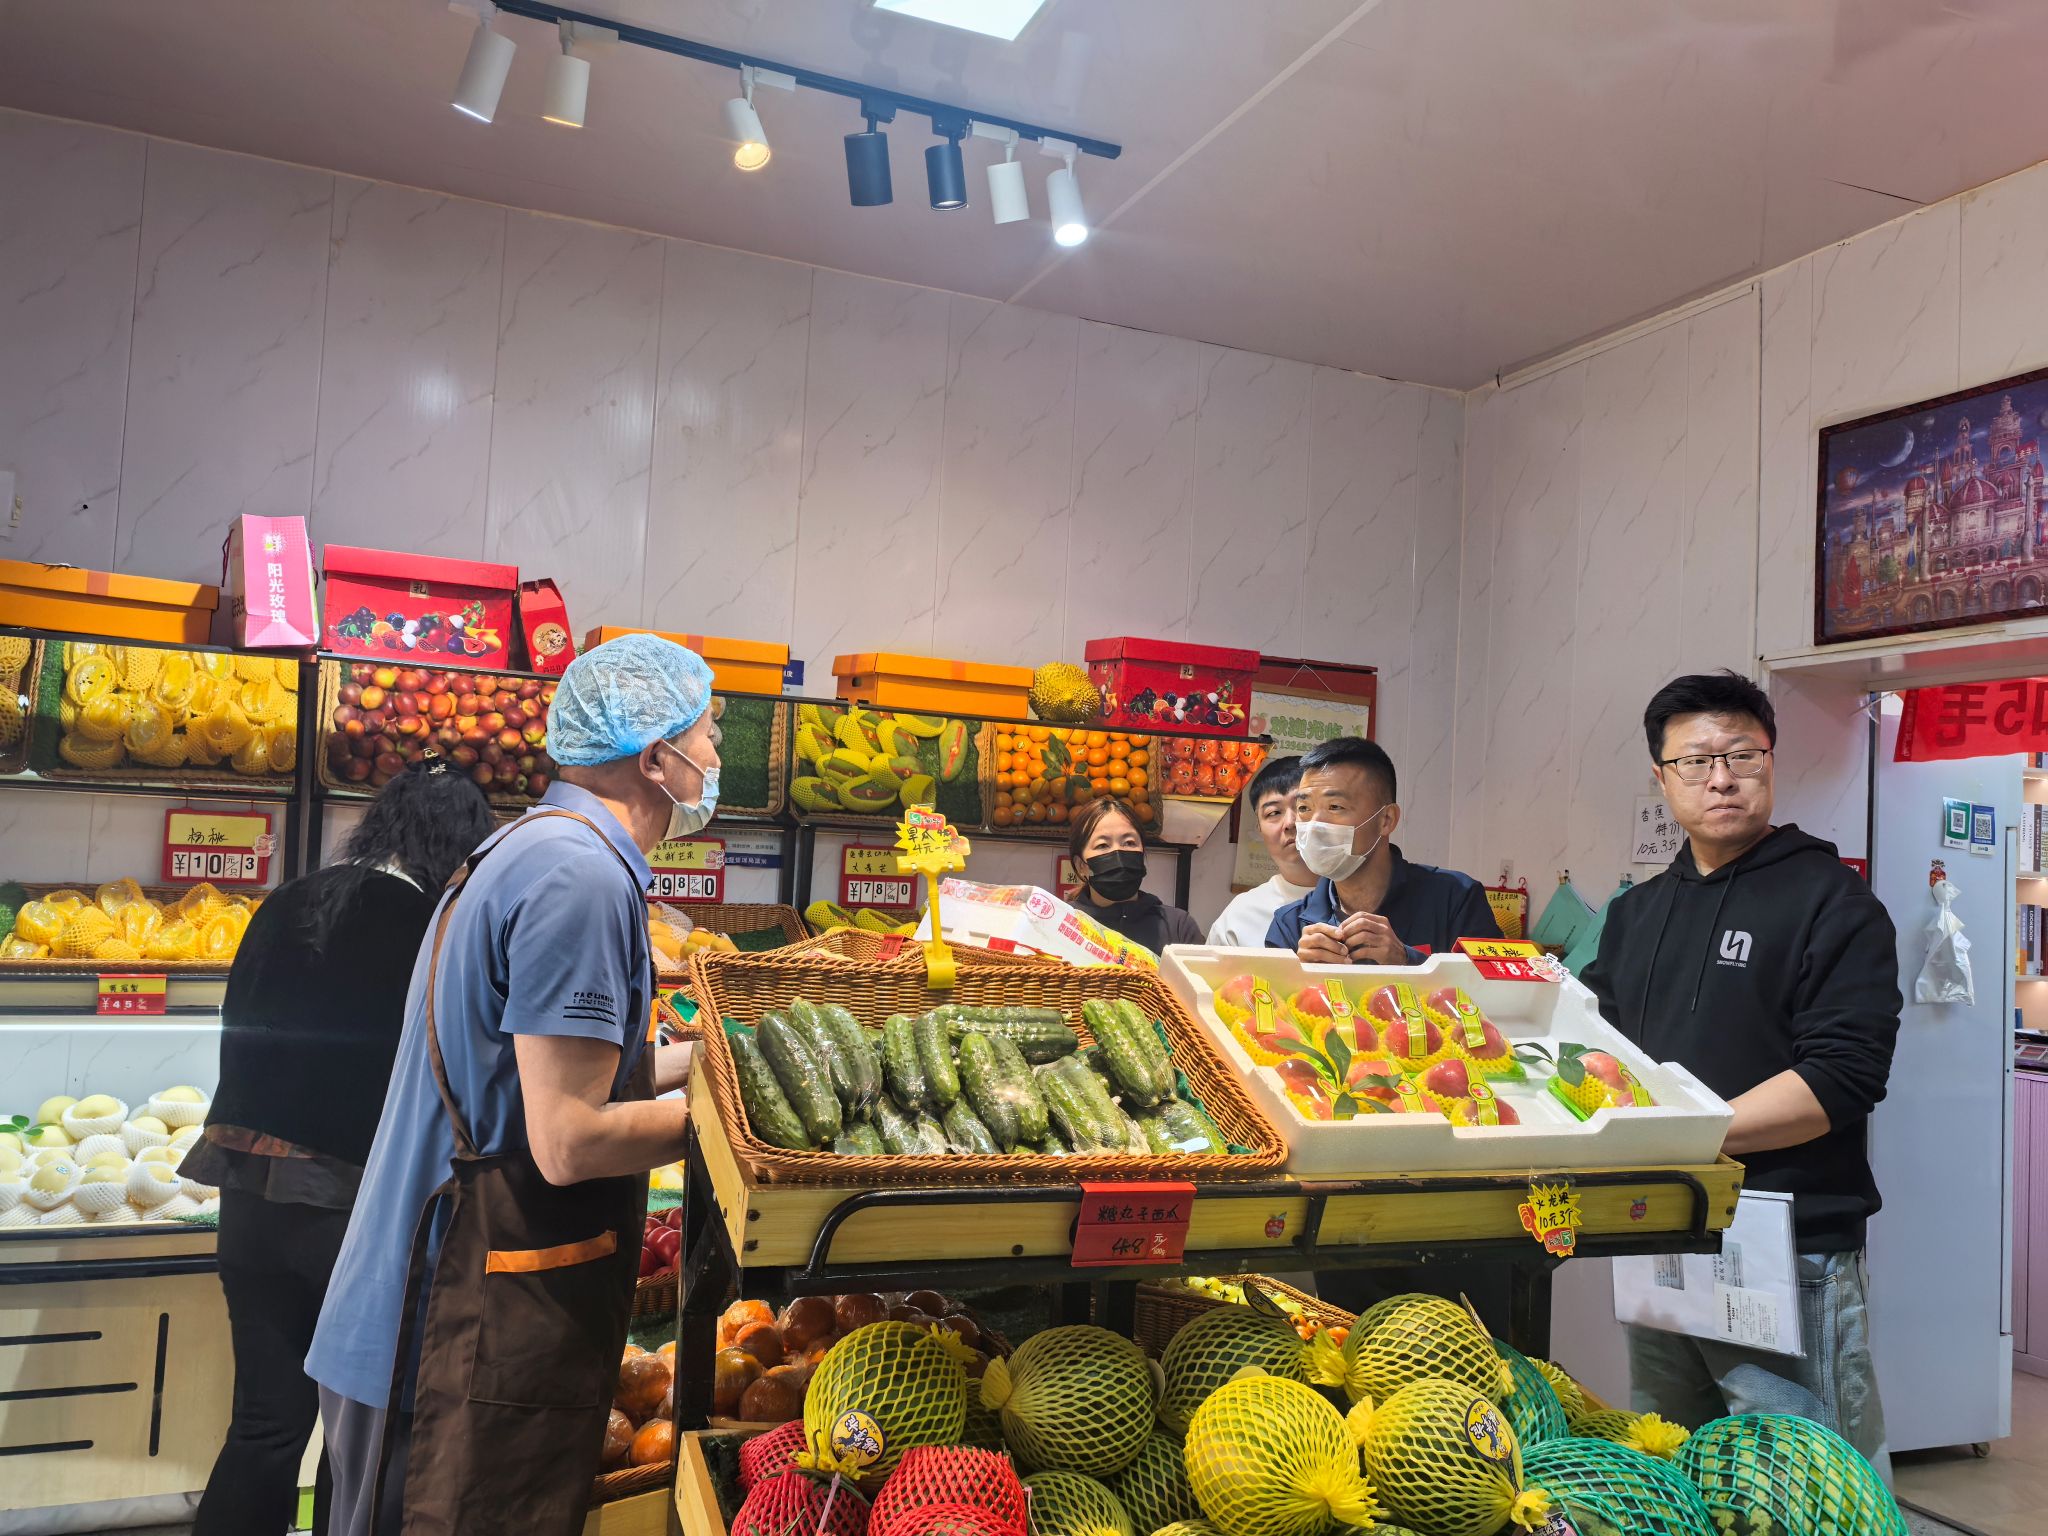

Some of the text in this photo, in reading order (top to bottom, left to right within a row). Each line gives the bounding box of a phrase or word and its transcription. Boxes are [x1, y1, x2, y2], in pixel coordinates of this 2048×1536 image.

[267, 563, 287, 623] 阳光玫瑰
[413, 583, 427, 595] 礼
[1182, 669, 1192, 679] 礼
[1270, 716, 1343, 741] 欢迎光临
[1641, 804, 1664, 822] 香蕉
[188, 827, 229, 845] 杨桃
[1656, 820, 1680, 837] 特价
[1637, 839, 1677, 857] 10元3斤
[1536, 1191, 1569, 1210] 火龙果
[1540, 1208, 1573, 1230] 10元3个
